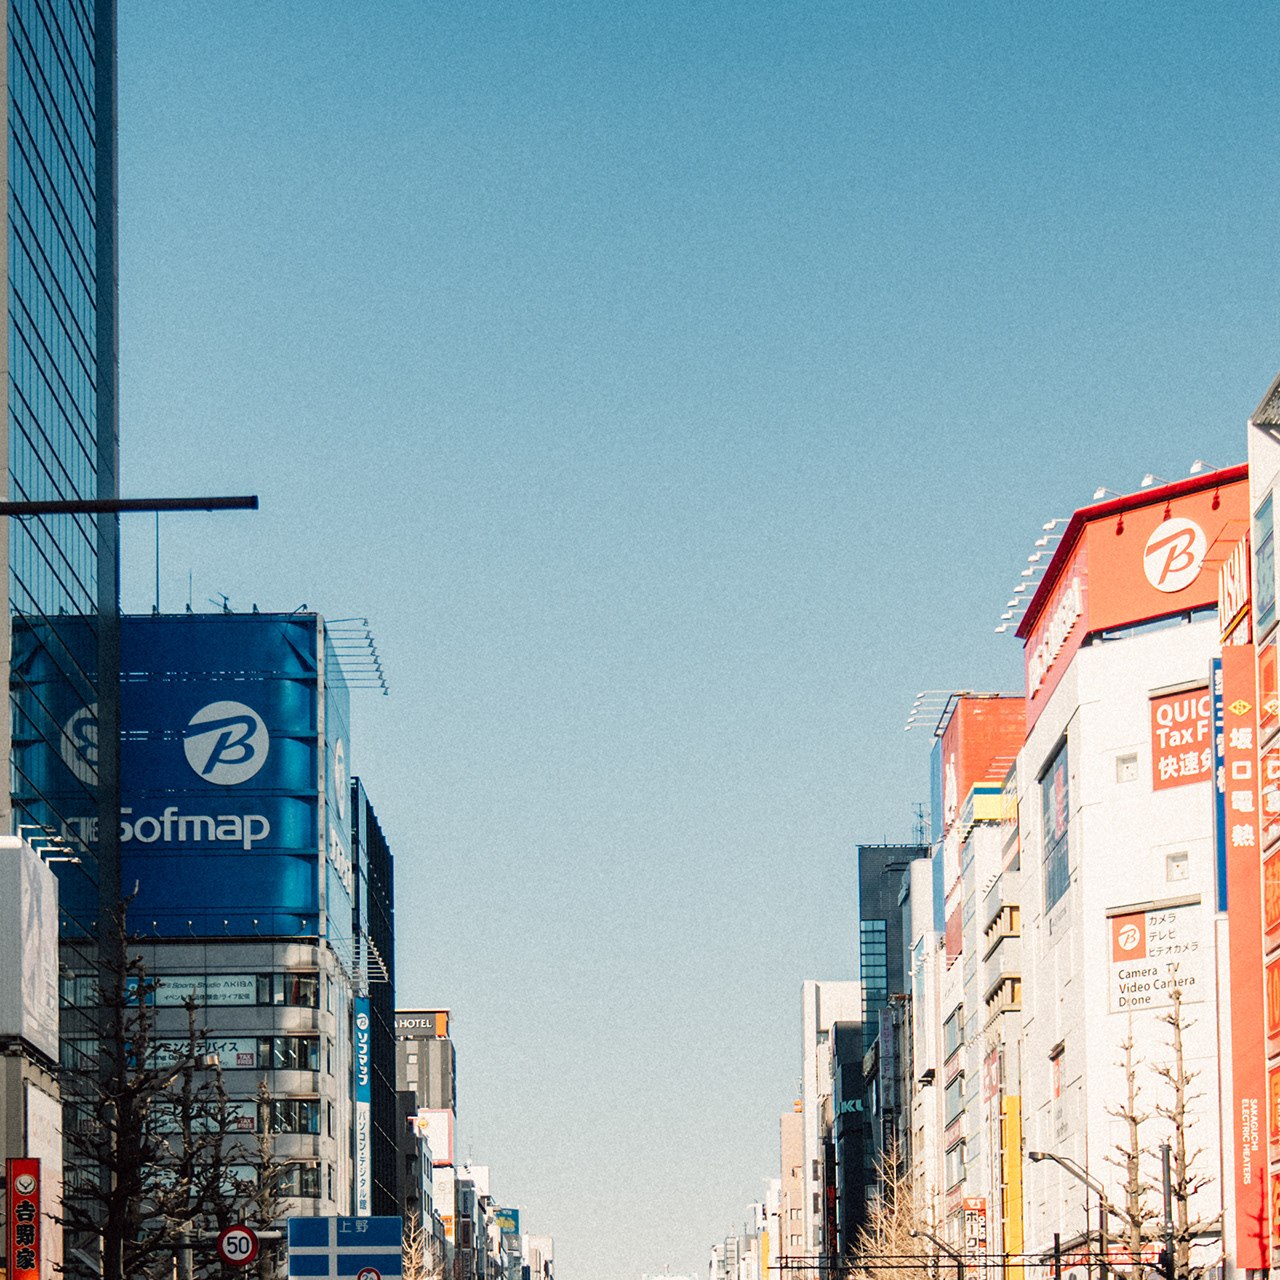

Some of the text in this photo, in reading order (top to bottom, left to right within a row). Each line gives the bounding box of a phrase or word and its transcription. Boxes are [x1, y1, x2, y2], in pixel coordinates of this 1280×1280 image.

[1156, 696, 1211, 726] QUIC
[1156, 722, 1193, 749] Tax
[1229, 727, 1256, 847] 坂口電熱
[1148, 912, 1177, 926] カメラ
[1148, 928, 1177, 942] テレビ
[1118, 961, 1181, 981] Camera TV
[1118, 974, 1196, 994] Video Camera
[1118, 993, 1151, 1008] Drone
[400, 1019, 432, 1028] HOTEL
[357, 1031, 368, 1086] ソフマップ
[1250, 1098, 1259, 1151] SAKAGUCHI
[1241, 1098, 1252, 1185] ELECTRIC HEATERS
[15, 1199, 36, 1270] 吉野家
[339, 1219, 368, 1233] 上野
[226, 1236, 249, 1255] 50
